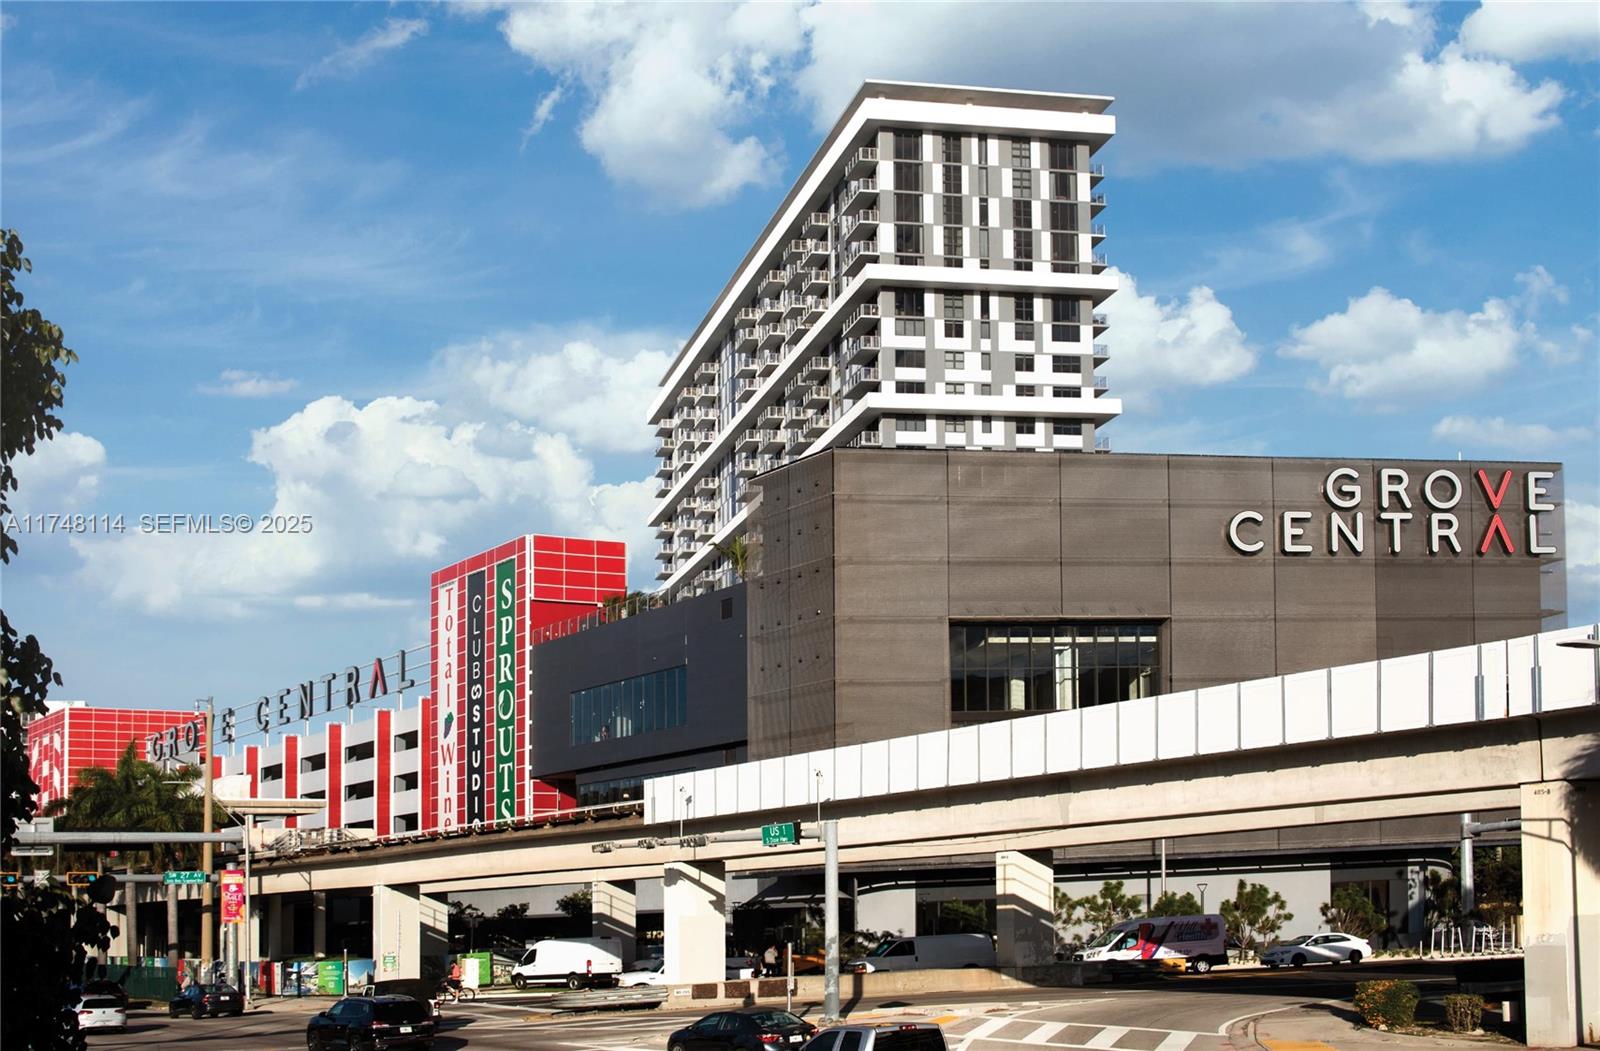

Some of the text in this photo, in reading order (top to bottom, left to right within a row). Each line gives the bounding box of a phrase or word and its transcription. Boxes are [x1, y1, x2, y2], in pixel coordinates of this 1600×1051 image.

[1325, 466, 1555, 511] GROVE
[1228, 510, 1557, 554] CENTRAL
[256, 650, 415, 731] CENTRAL
[441, 587, 456, 830] Total Wine
[472, 594, 482, 831] CLUB STUDIO
[498, 577, 514, 822] SPROUTS
[769, 826, 780, 836] US
[180, 871, 190, 879] 27
